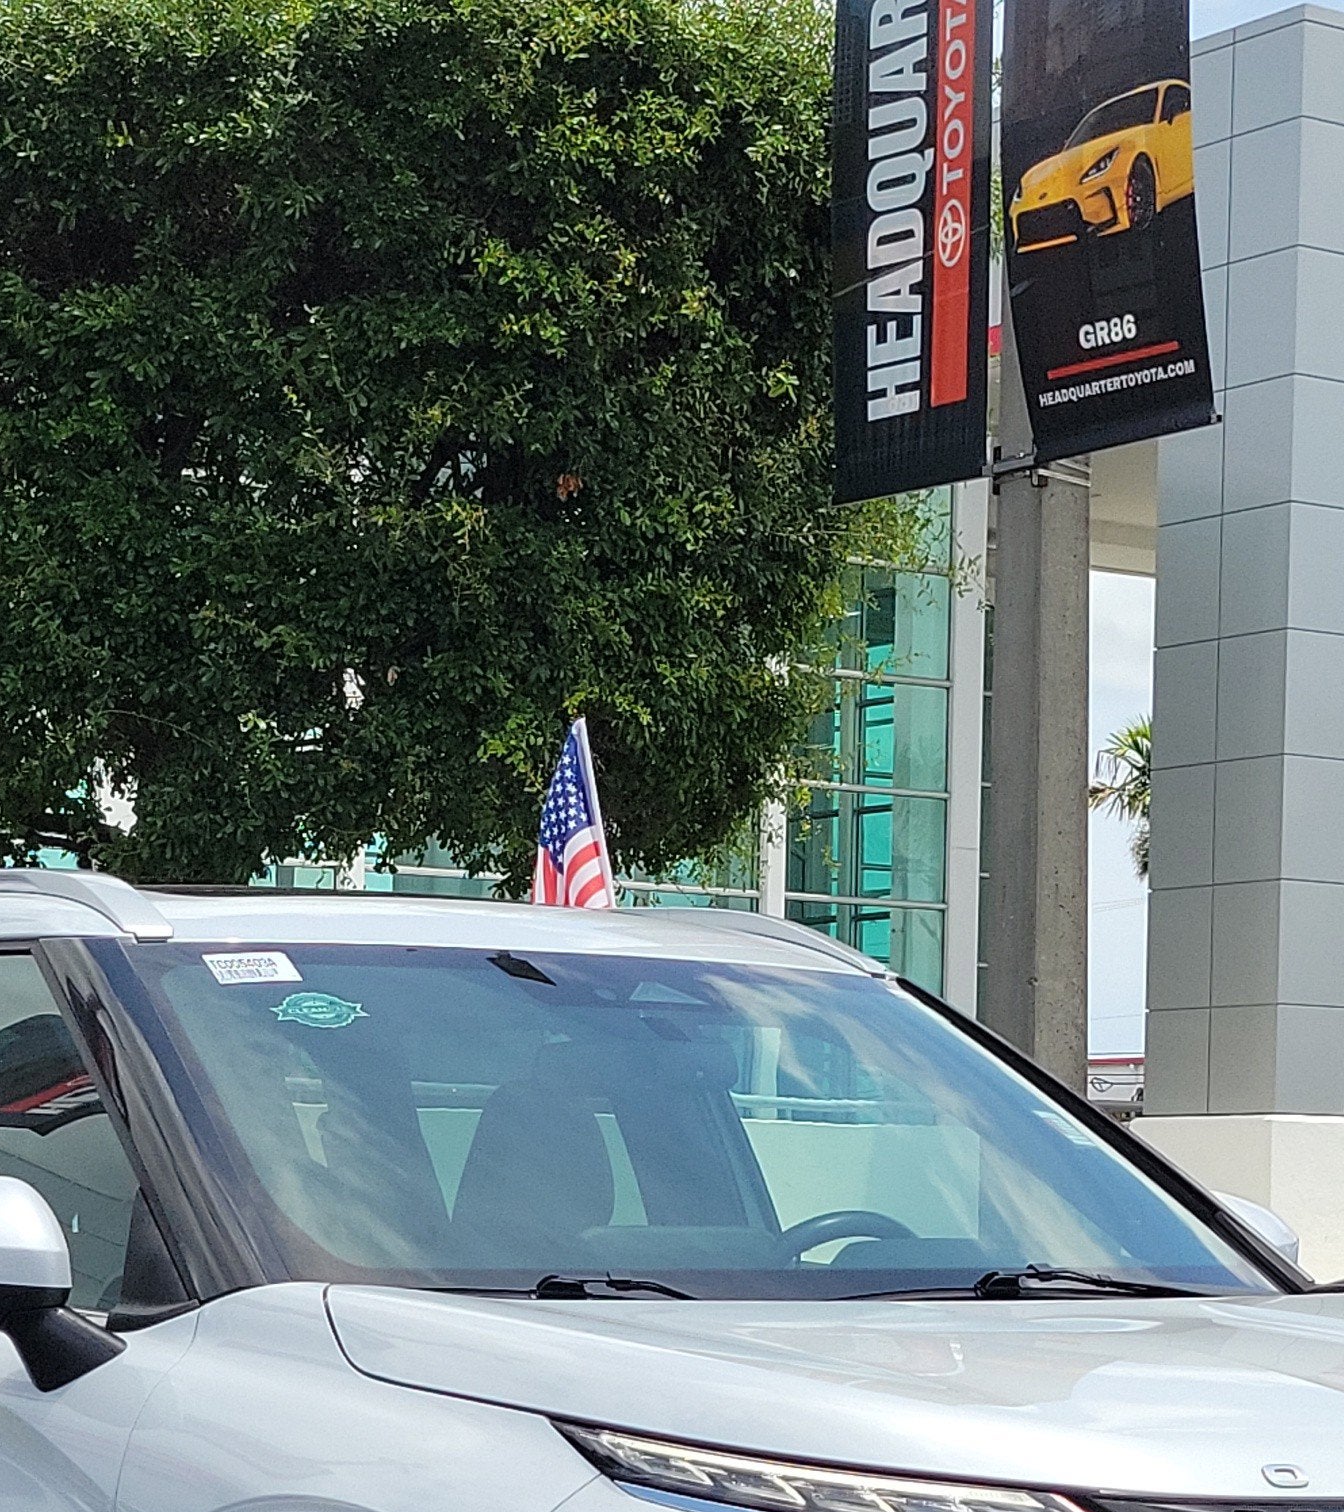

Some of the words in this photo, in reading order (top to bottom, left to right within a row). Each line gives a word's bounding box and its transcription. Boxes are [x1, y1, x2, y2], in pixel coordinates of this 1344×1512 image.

[942, 0, 967, 195] TOYOT
[867, 0, 934, 421] HEADQUAR
[1039, 359, 1196, 407] HEADQUARTERTOYOTA.COM
[1078, 314, 1137, 349] GR86
